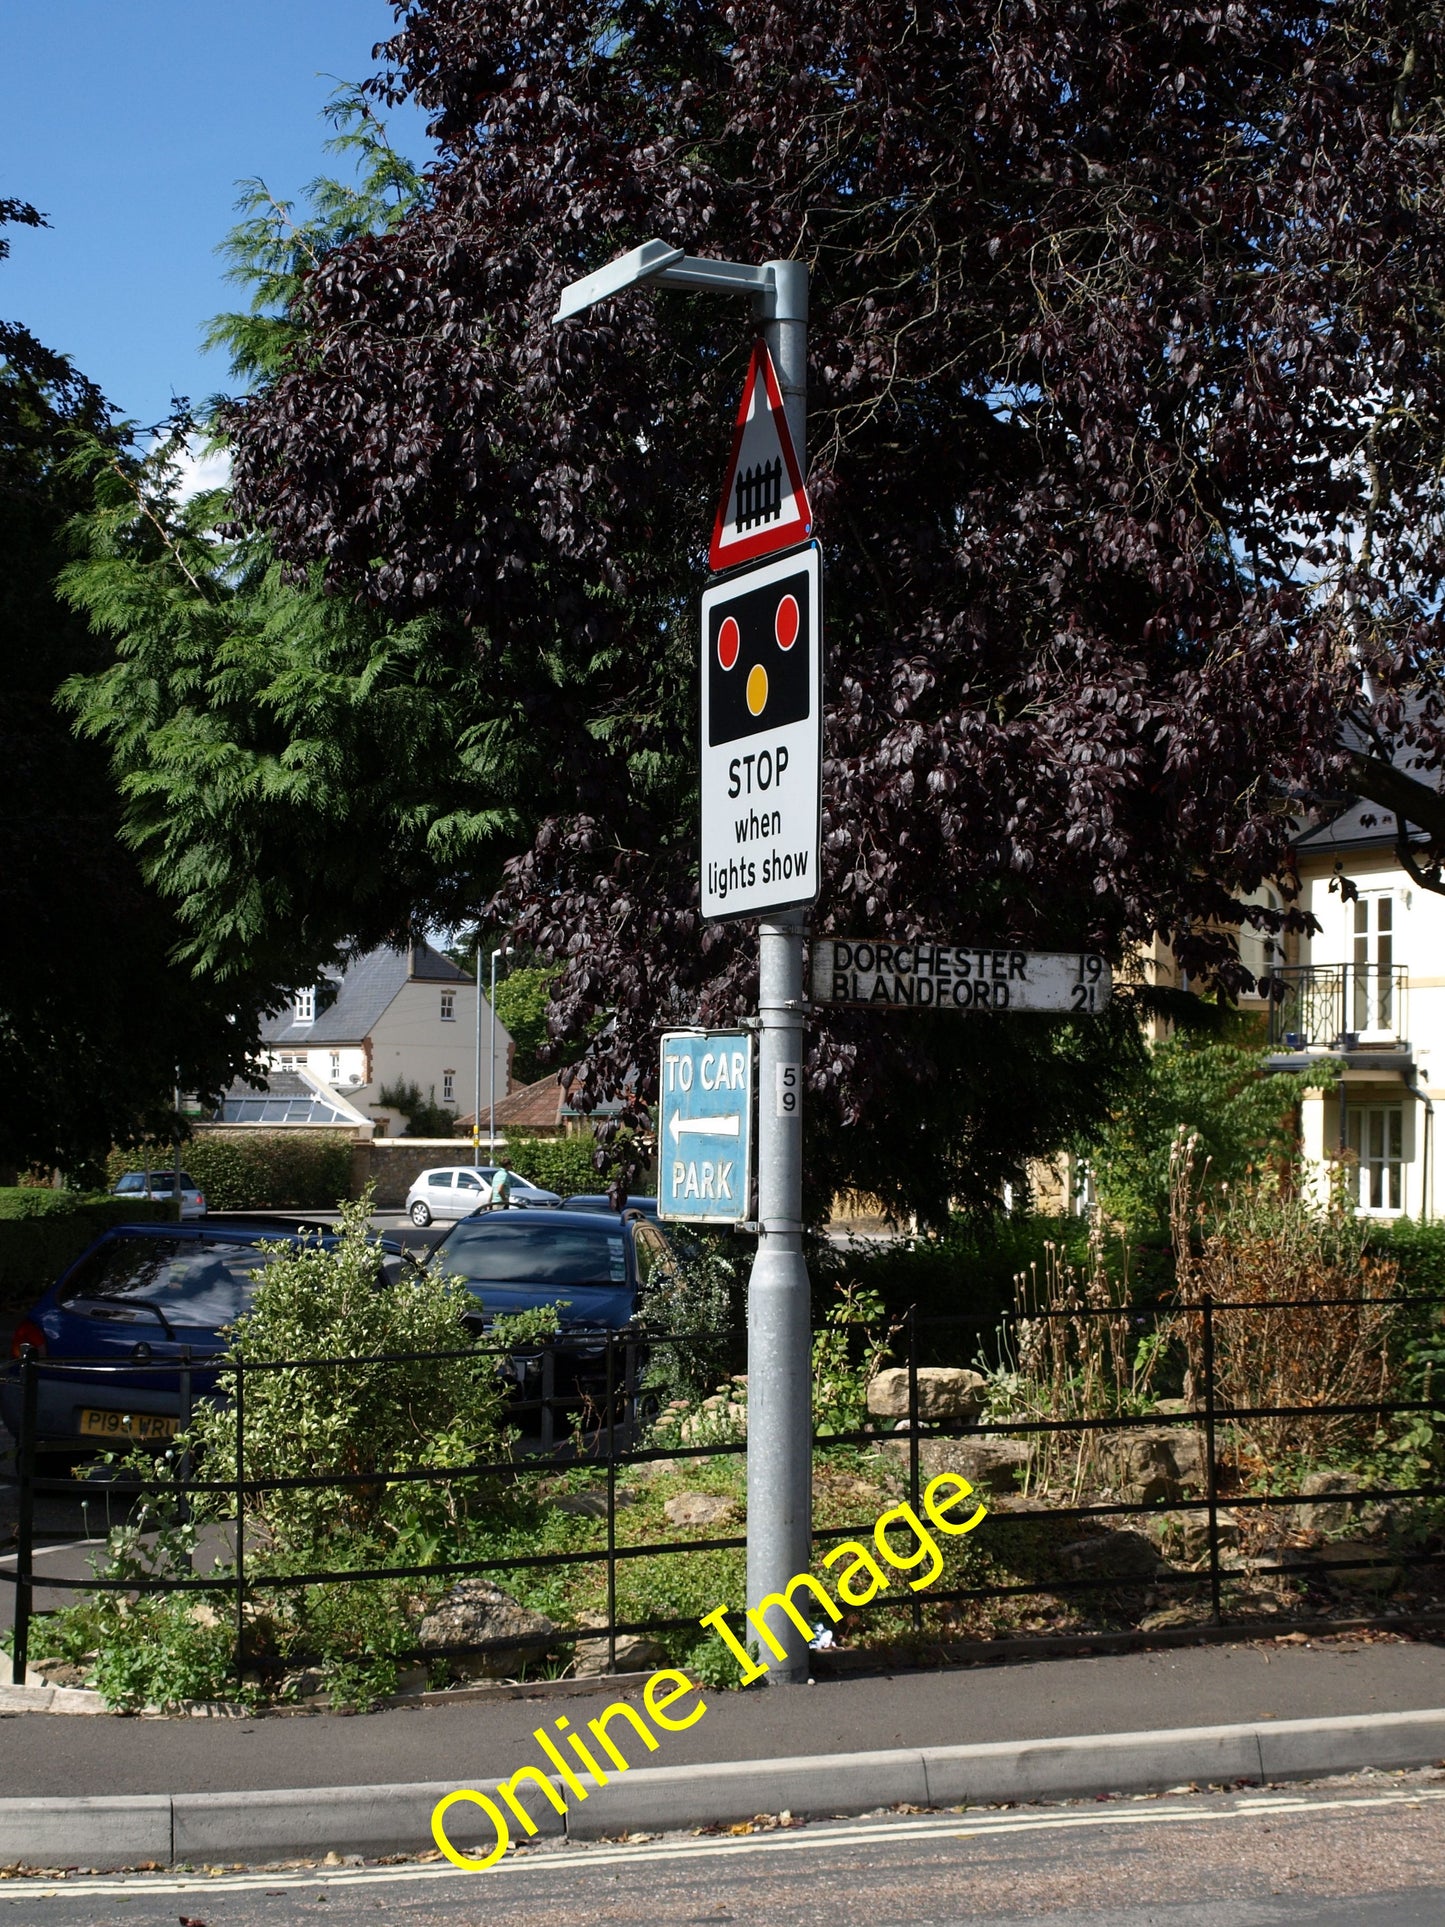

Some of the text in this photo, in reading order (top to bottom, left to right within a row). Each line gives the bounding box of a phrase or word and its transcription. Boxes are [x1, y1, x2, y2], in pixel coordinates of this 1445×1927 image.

[728, 745, 789, 799] STOP
[735, 810, 782, 844] when
[708, 850, 809, 900] lights show
[832, 942, 1102, 983] DORCHESTER 19
[832, 973, 1096, 1013] BLANDFORD 21
[665, 1052, 746, 1092] TO CAR
[672, 1160, 734, 1200] PARK
